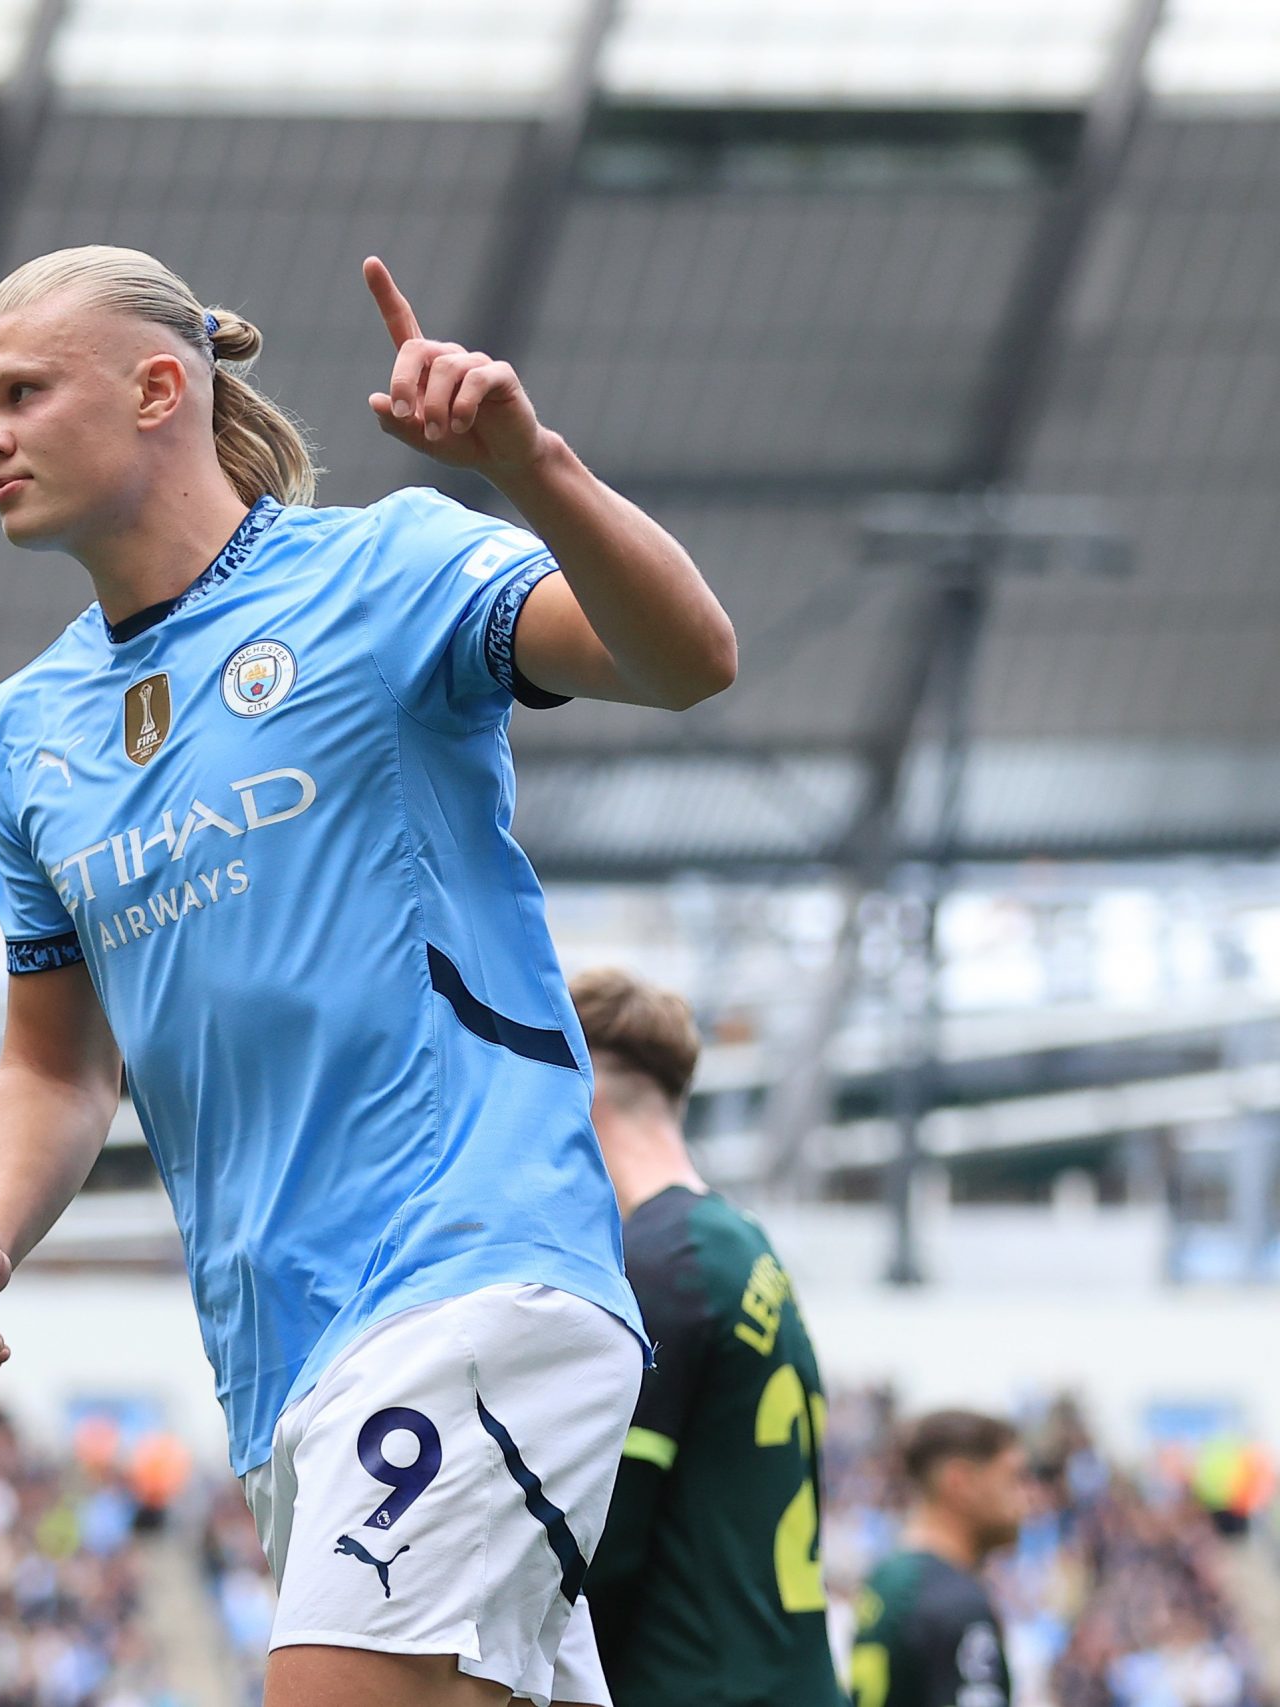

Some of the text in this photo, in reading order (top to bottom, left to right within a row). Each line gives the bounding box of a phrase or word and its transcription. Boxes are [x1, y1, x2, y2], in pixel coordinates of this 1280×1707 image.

[228, 644, 288, 677] MANCHESTER
[247, 701, 270, 713] CITY
[136, 730, 158, 750] FIFA
[50, 767, 317, 915] ETIHAD
[98, 859, 250, 953] AIRWAYS
[357, 1406, 442, 1530] 9
